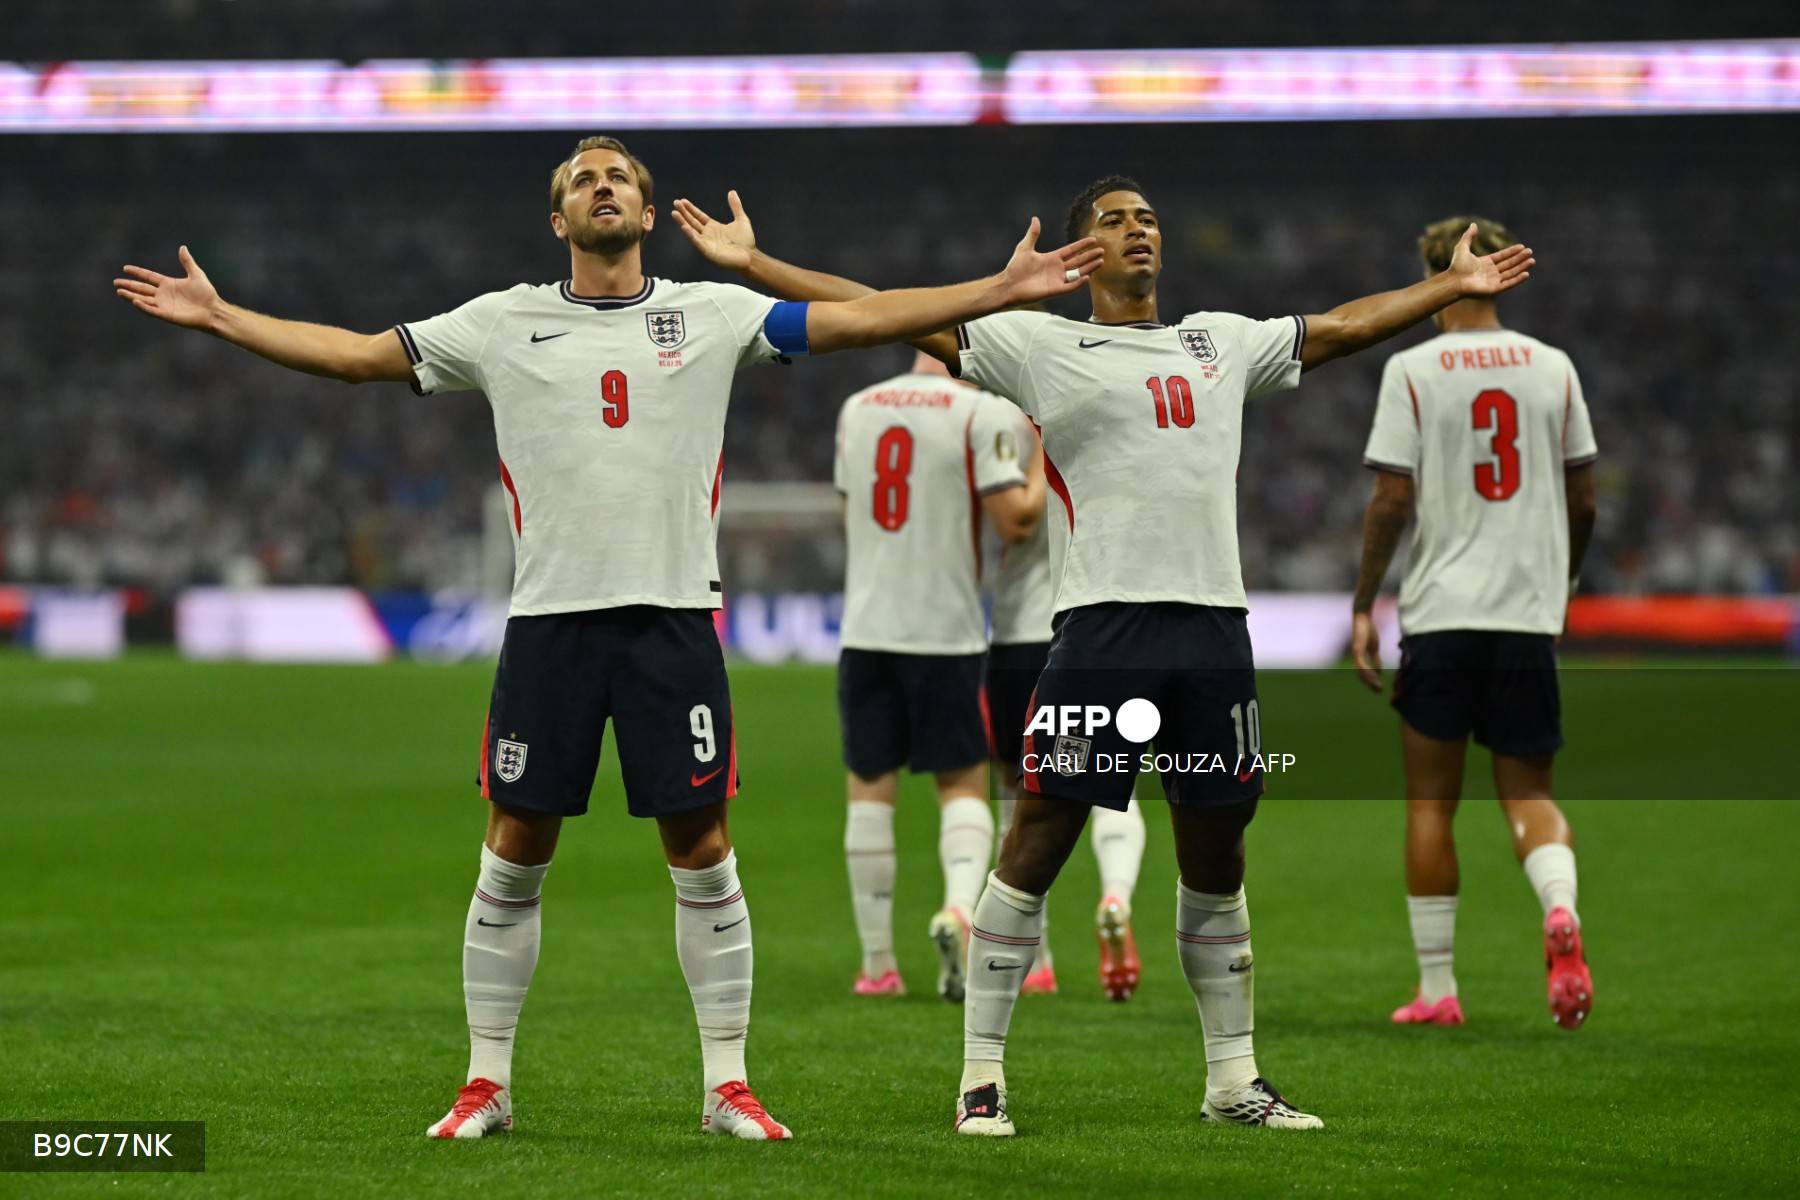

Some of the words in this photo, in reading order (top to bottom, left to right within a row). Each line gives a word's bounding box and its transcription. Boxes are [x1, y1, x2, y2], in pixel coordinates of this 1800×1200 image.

[1440, 346, 1532, 372] O'REILLY
[600, 369, 630, 429] 9
[1146, 375, 1195, 429] 10
[1471, 388, 1521, 502] 3
[872, 426, 914, 532] 8
[689, 703, 718, 763] 9
[1230, 699, 1261, 760] 10
